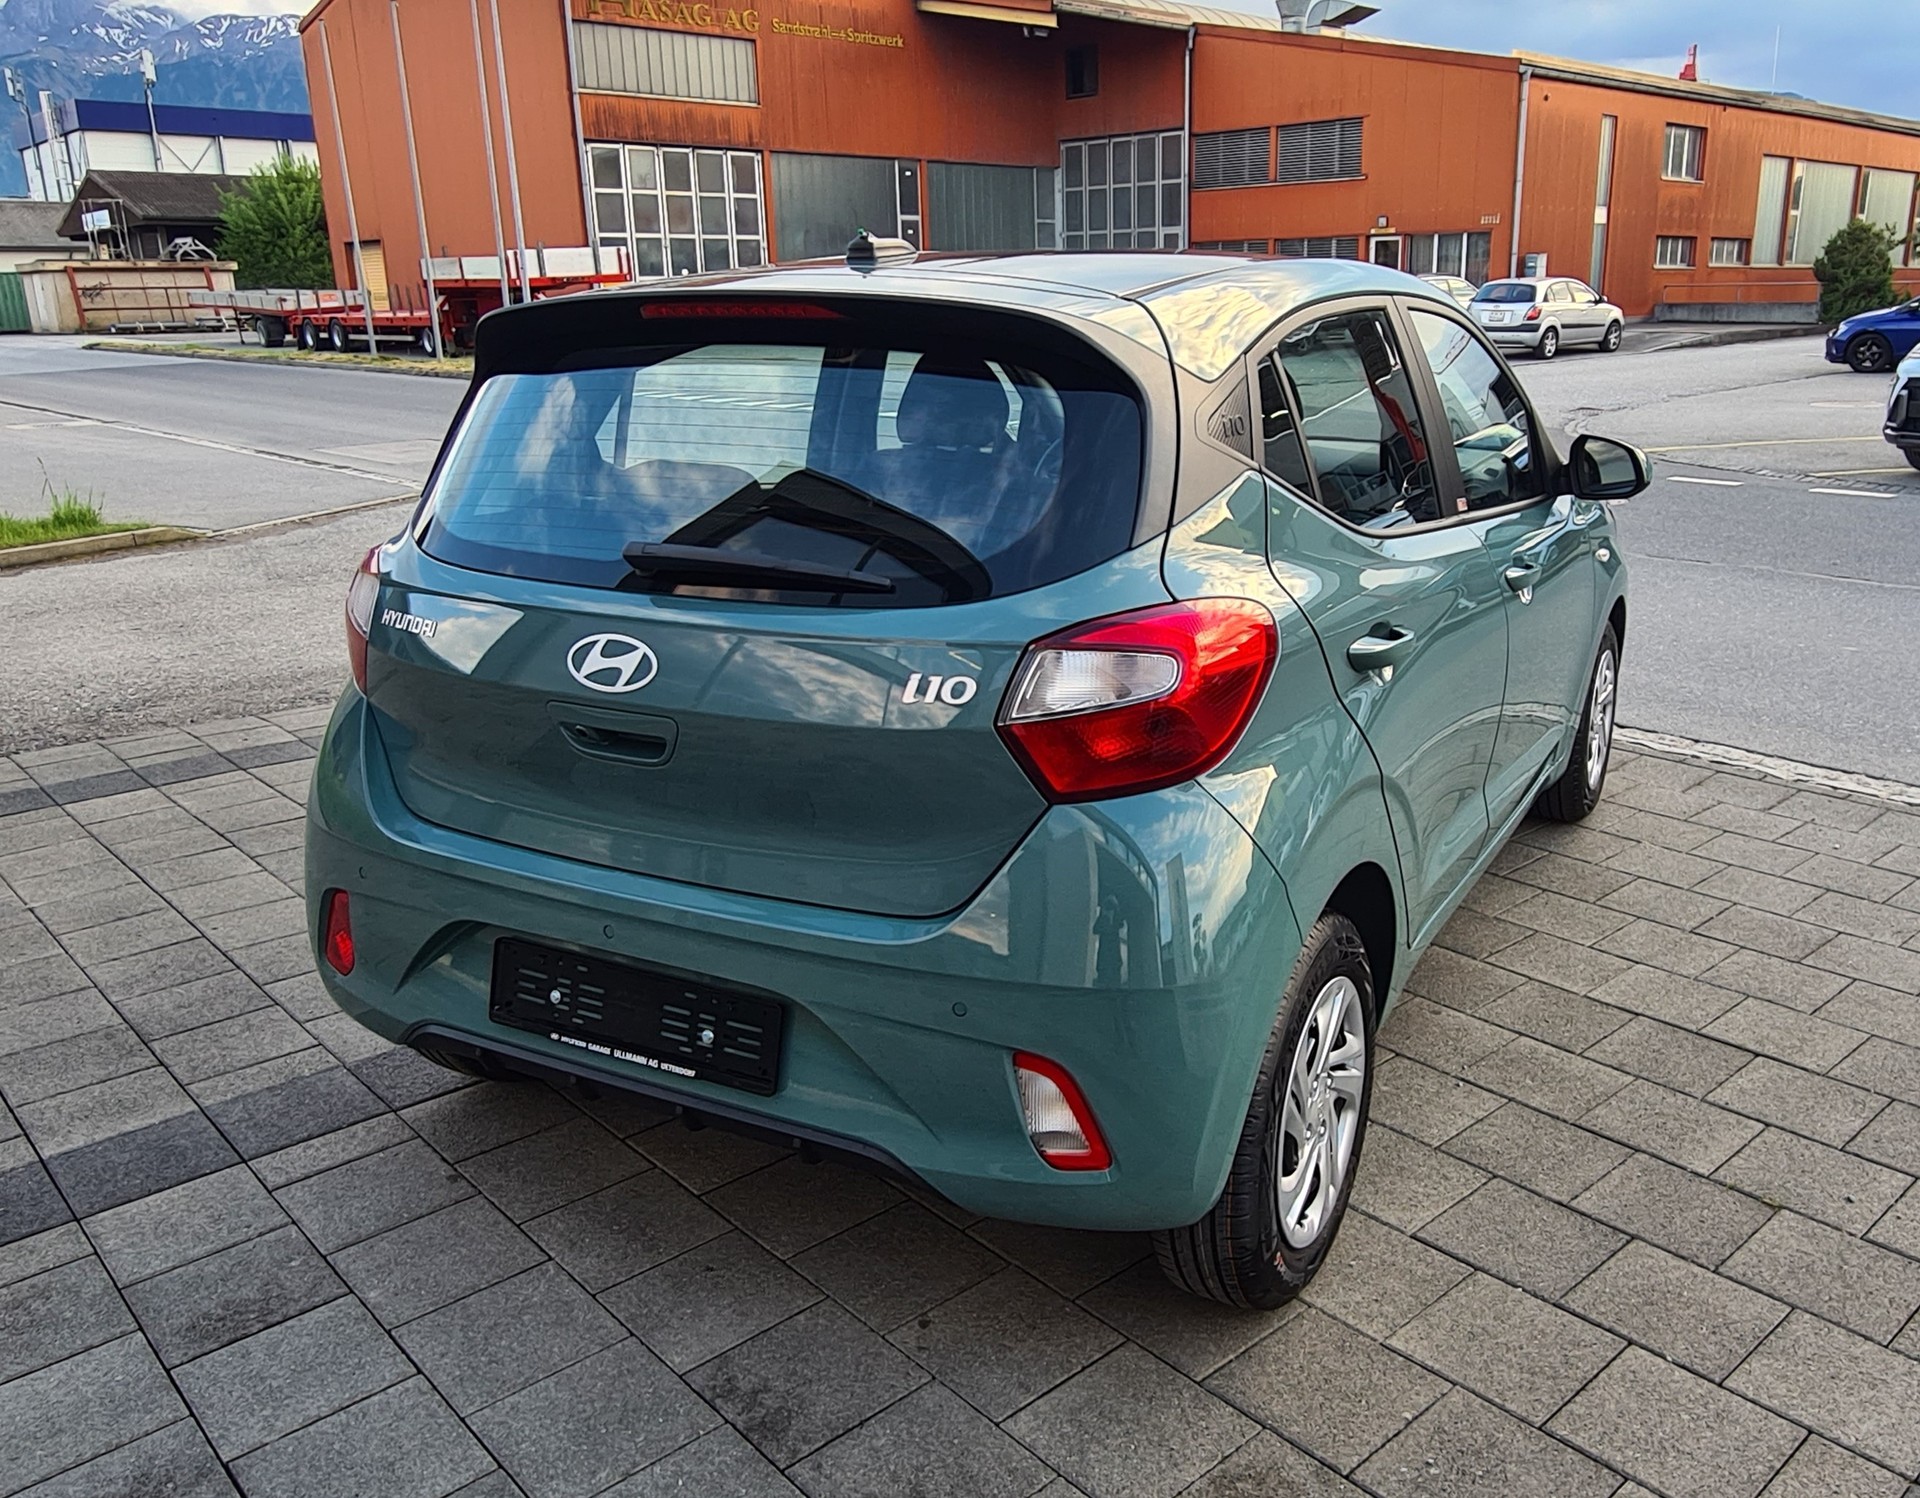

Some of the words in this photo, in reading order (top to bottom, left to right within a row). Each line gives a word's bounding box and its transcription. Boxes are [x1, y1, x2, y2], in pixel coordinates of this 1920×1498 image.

[724, 8, 760, 33] AG
[847, 28, 904, 48] Spritzwerk
[1221, 414, 1245, 438] i10
[381, 608, 438, 638] HYUNDAI
[902, 672, 977, 705] i10
[613, 1048, 648, 1066] ULLMANN
[648, 1058, 659, 1069] AG
